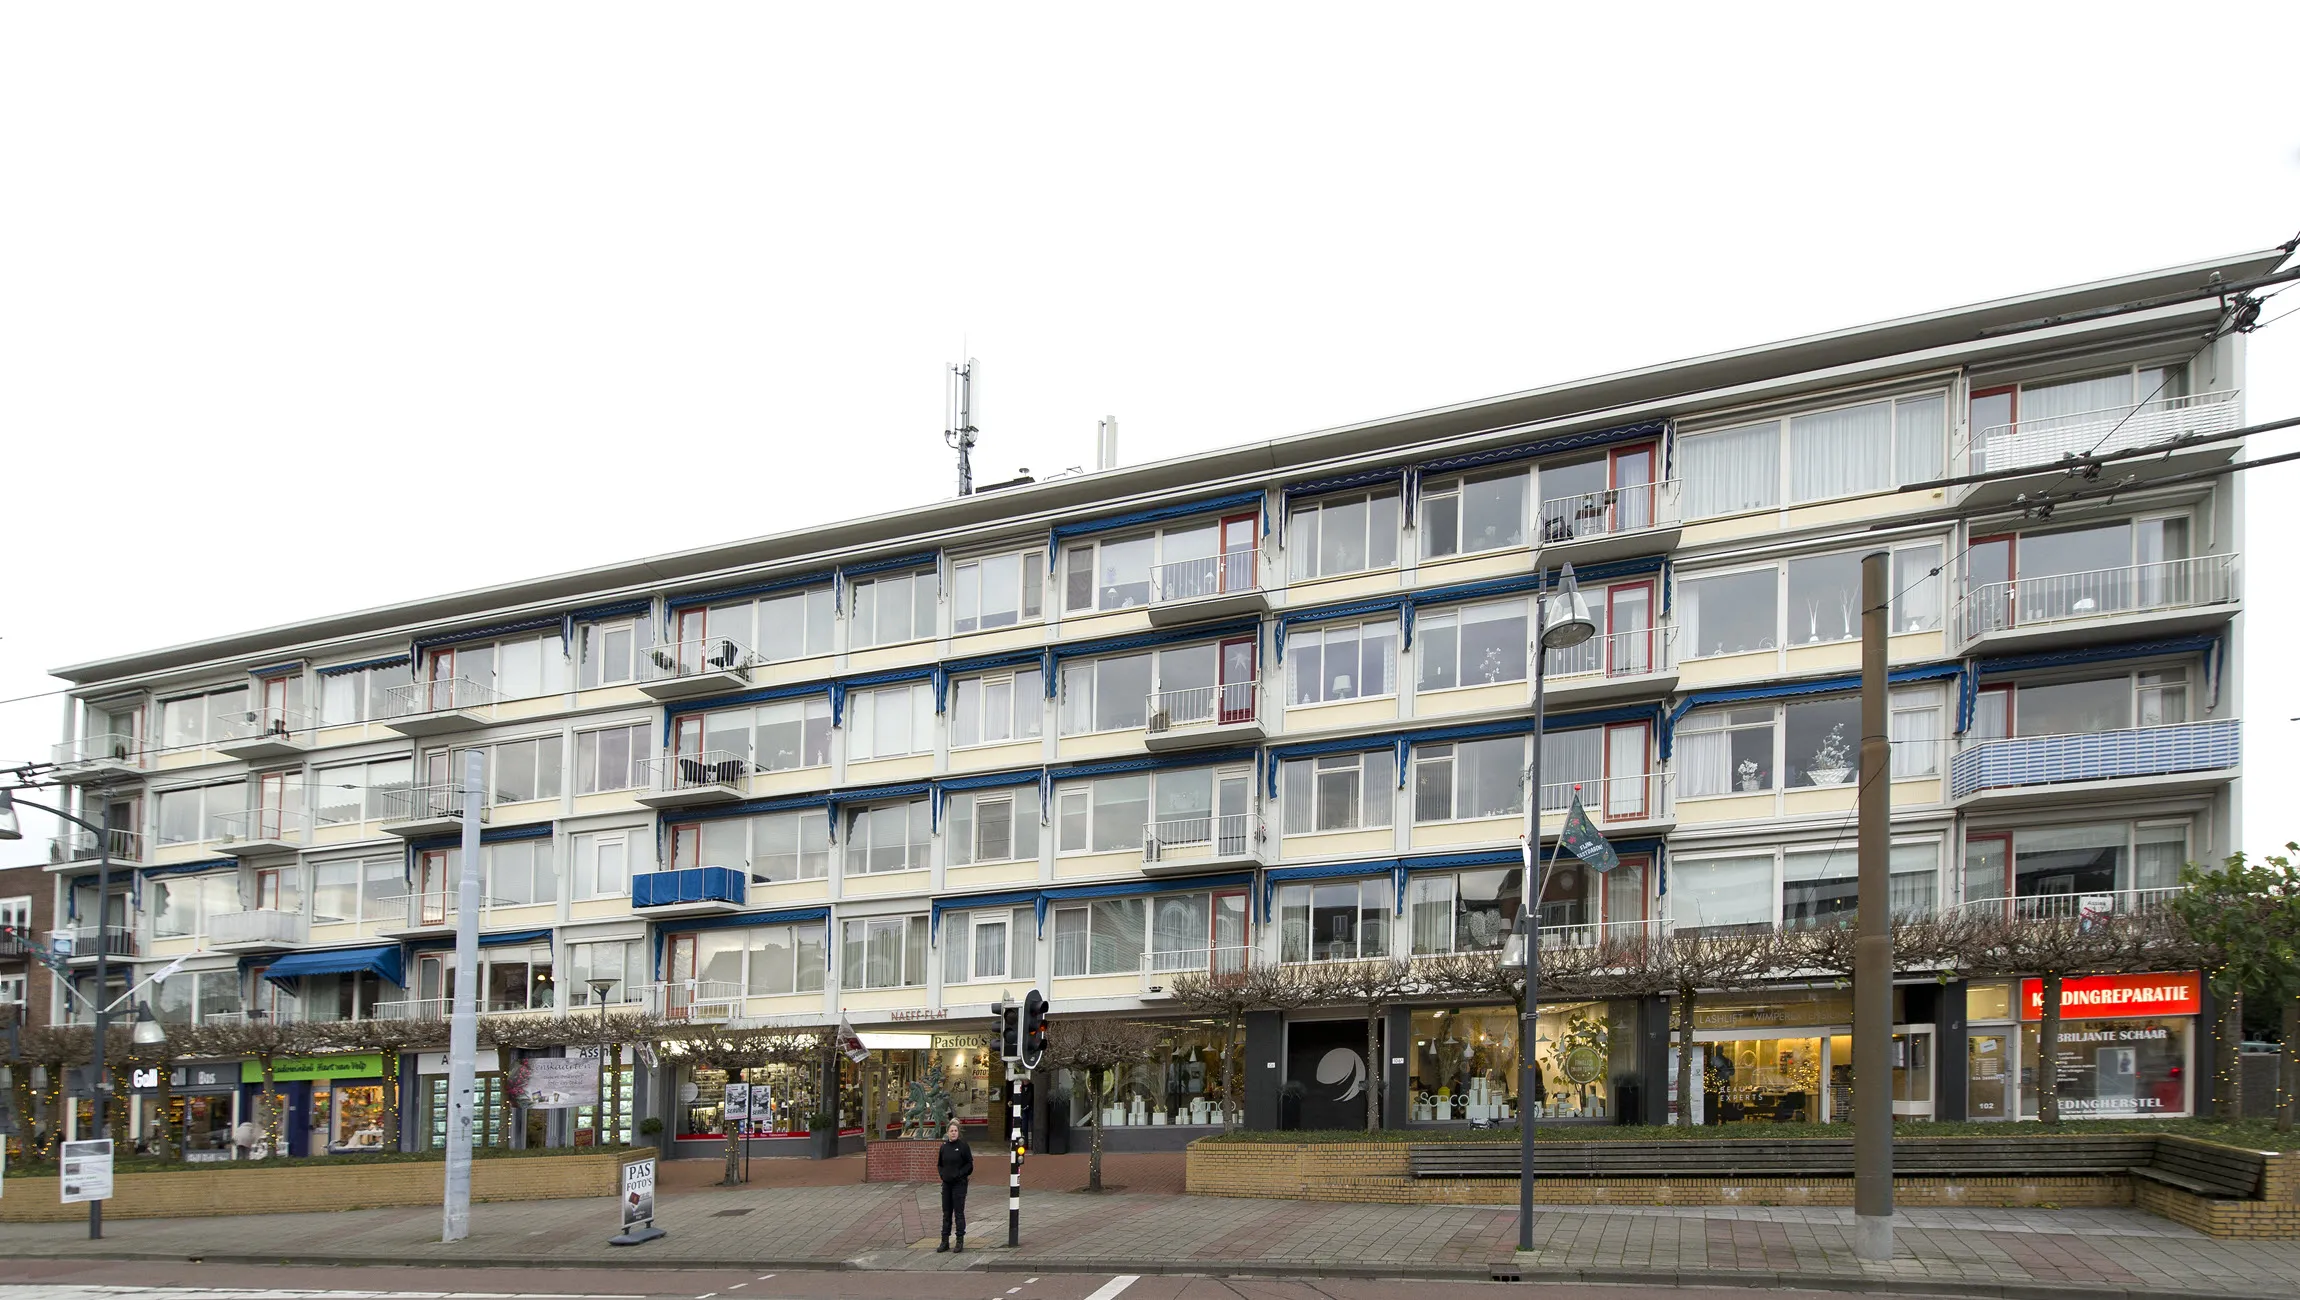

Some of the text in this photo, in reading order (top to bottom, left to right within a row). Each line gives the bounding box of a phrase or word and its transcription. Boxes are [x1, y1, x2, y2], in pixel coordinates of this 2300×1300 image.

[2032, 986, 2189, 1006] KDINGREPARATIE
[1700, 1013, 1743, 1024] LASHLIFT
[934, 1034, 987, 1049] Pasfoto's
[2119, 1029, 2167, 1041] SCHAAR
[1720, 1094, 1763, 1102] EXPERTS
[2057, 1098, 2164, 1109] EDINGHERSTEL
[629, 1162, 651, 1180] PAS
[626, 1177, 653, 1192] FOTO'S
